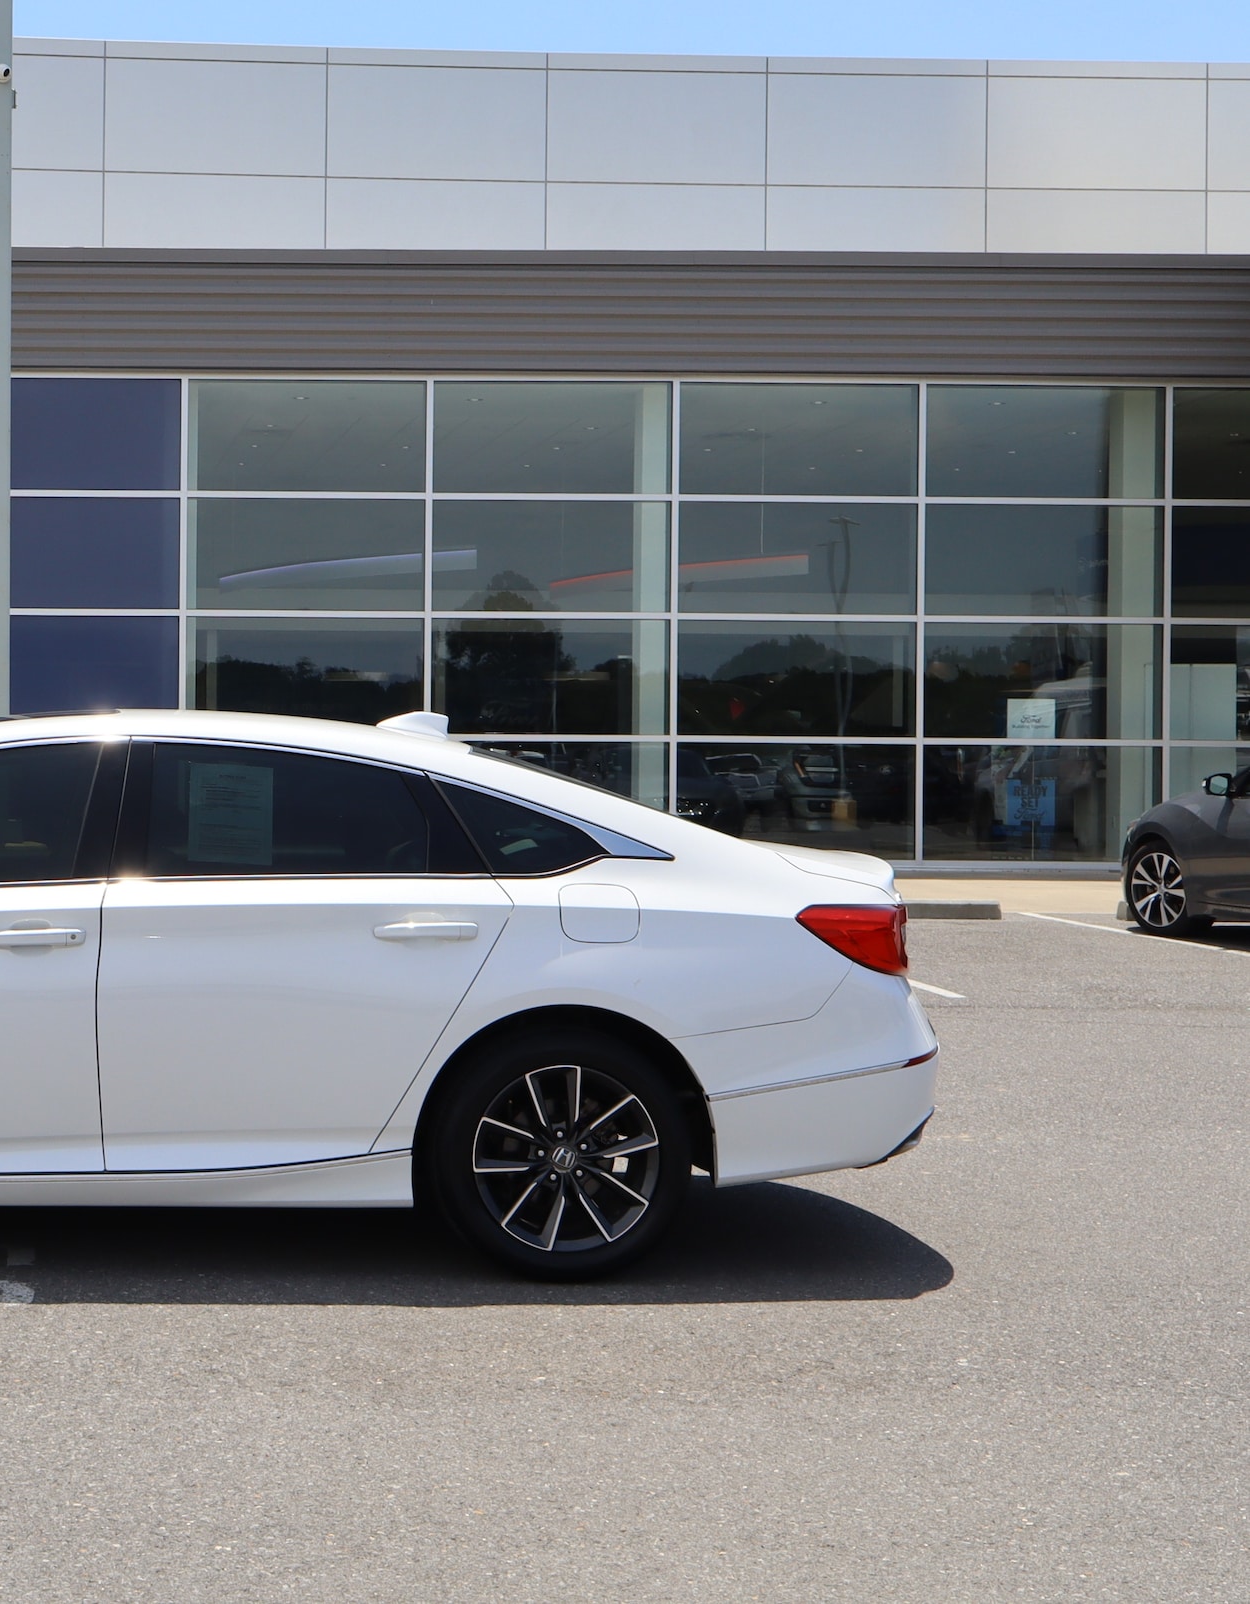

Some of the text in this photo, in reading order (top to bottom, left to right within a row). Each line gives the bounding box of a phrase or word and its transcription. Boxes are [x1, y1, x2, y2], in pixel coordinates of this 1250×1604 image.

[1020, 715, 1042, 724] Ford
[1014, 786, 1047, 797] READY
[1021, 797, 1040, 809] SET
